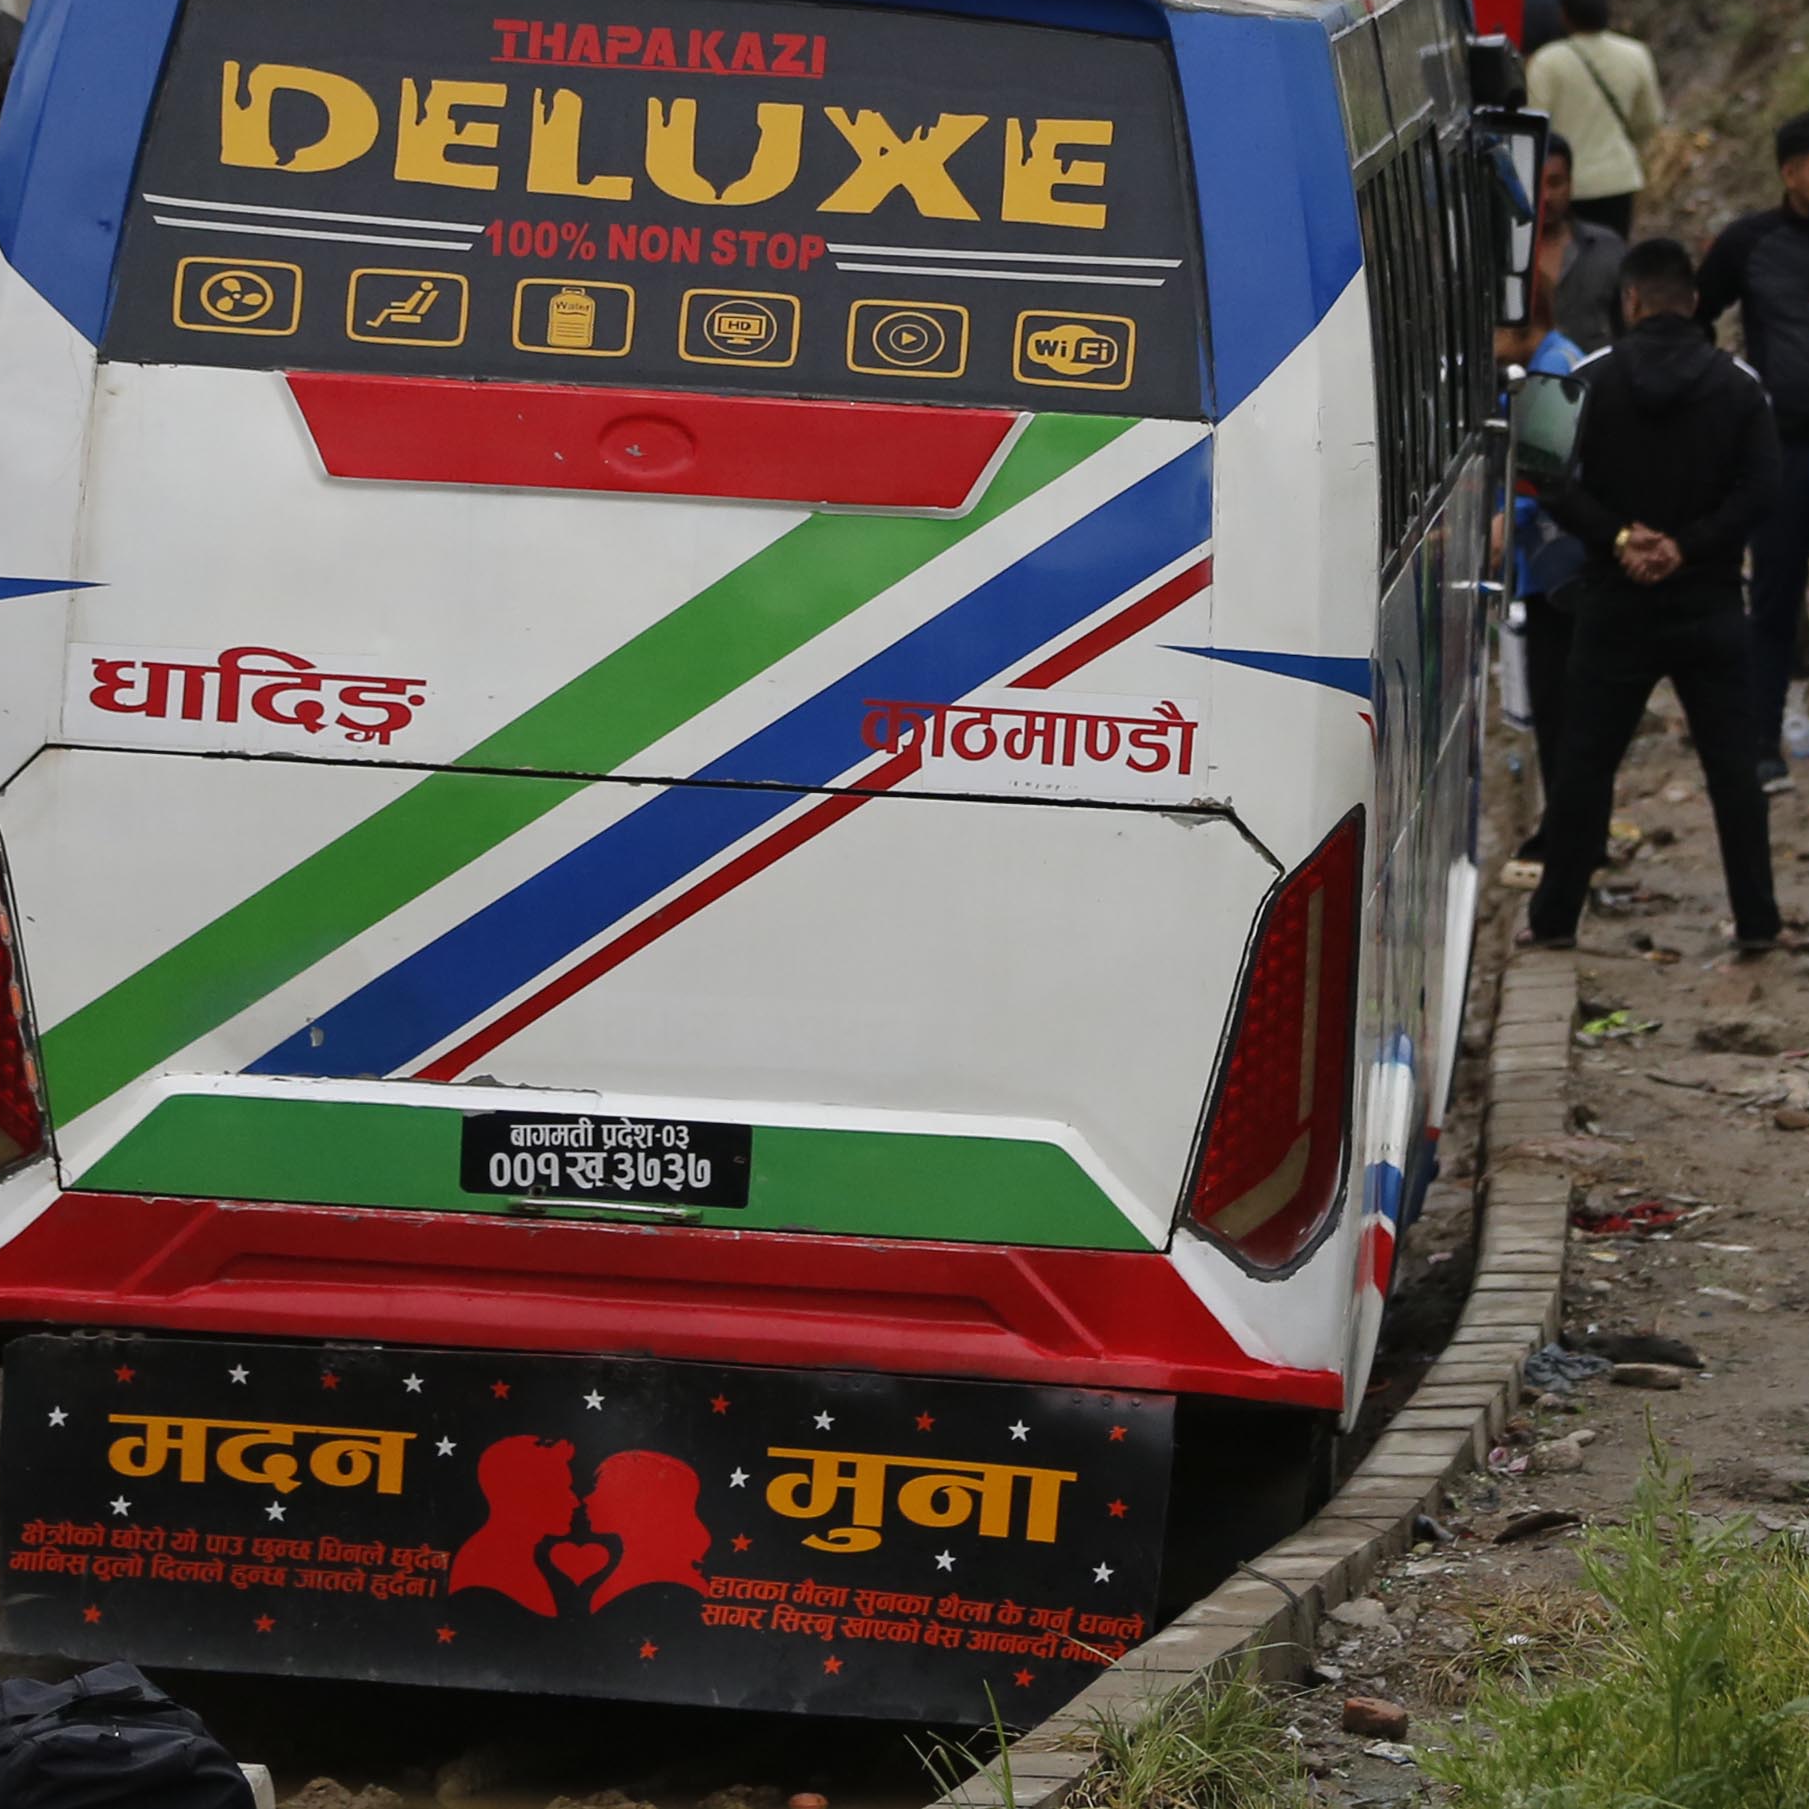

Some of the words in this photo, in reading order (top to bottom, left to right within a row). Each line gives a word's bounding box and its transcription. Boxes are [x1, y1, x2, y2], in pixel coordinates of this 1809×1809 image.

[492, 19, 677, 68] THAPA
[687, 29, 827, 79] KAZI
[221, 60, 1113, 229] DELUXE
[486, 220, 597, 261] 100%
[608, 224, 701, 264] NON
[711, 229, 825, 272] STOP
[555, 300, 590, 313] Water
[728, 320, 752, 331] HD
[860, 698, 1199, 776] काठमाण्डौ
[510, 1117, 595, 1148] बागमती
[612, 1152, 711, 1191] ३७३७
[109, 1413, 418, 1495] मदन
[766, 1446, 1078, 1554] मुना
[8, 1543, 89, 1575] मानिस
[170, 1528, 199, 1552] यो
[709, 1576, 790, 1602] हातका
[792, 1578, 851, 1608] मैला
[853, 1588, 933, 1617] सुनका
[997, 1599, 1026, 1625] के
